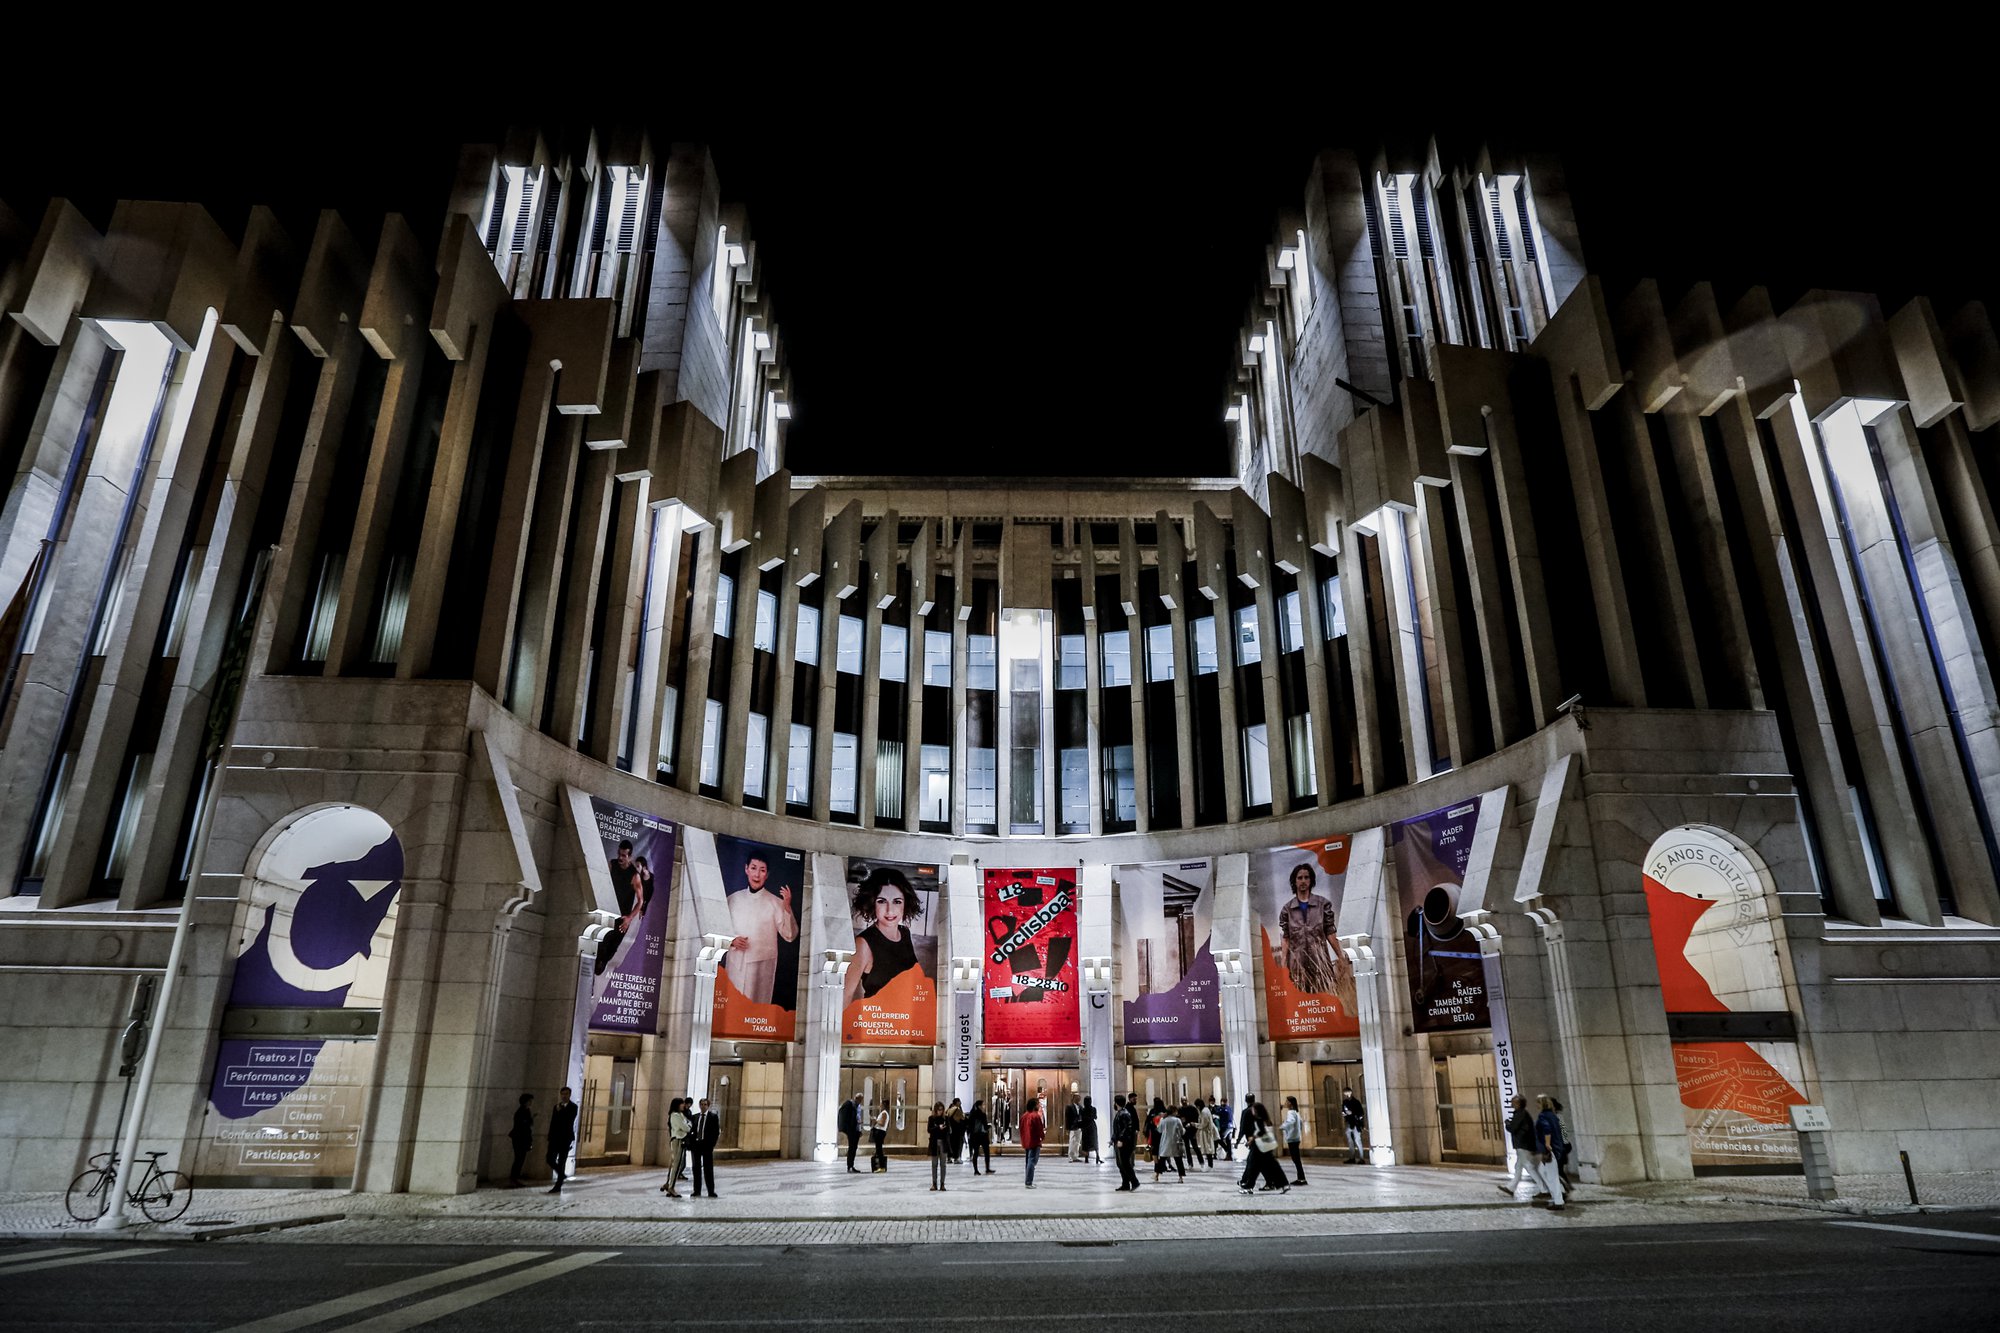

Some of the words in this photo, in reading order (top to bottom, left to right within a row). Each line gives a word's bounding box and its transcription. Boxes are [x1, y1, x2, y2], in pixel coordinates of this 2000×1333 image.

[594, 812, 632, 830] CONCERTOS
[614, 810, 624, 818] OS
[626, 814, 639, 824] SEIS
[600, 822, 638, 839] BRANDEBUR
[600, 830, 620, 842] UESES
[1442, 824, 1464, 838] KADER
[1440, 836, 1456, 846] ATTIA
[1652, 862, 1668, 880] 25
[1667, 848, 1704, 866] ANOS
[1710, 855, 1752, 938] CULTURGEST
[992, 894, 1074, 964] doclisboa
[606, 972, 624, 980] ANNE
[625, 974, 646, 983] TERESA
[648, 978, 656, 986] DE
[1452, 980, 1462, 988] AS
[610, 981, 654, 992] KEERSMAEKER
[1458, 986, 1482, 996] RAÍZES
[623, 991, 644, 1000] ROSAS,
[598, 997, 632, 1007] AMANDINE
[634, 1000, 652, 1009] BEYER
[1298, 1000, 1320, 1008] JAMES
[1434, 996, 1463, 1007] TAMBÉM
[1464, 996, 1474, 1004] SE
[1294, 1010, 1299, 1018] &
[1308, 1006, 1336, 1014] HOLDEN
[1428, 1008, 1450, 1016] CRIAM
[1450, 1006, 1462, 1014] NO
[602, 1014, 640, 1024] ORCHESTRA
[872, 1012, 910, 1020] GUERREIRO
[1286, 1018, 1299, 1026] THE
[1300, 1016, 1327, 1024] ANIMAL
[1453, 1012, 1475, 1022] BETÃO
[1292, 1024, 1316, 1032] SPIRITS
[958, 1014, 972, 1082] Culturgest
[254, 1052, 286, 1062] Teatro
[1680, 1054, 1706, 1064] Teatro
[230, 1072, 296, 1082] Performance
[1742, 1066, 1772, 1077] Música
[1496, 1040, 1515, 1122] ulturgest
[1678, 1068, 1729, 1090] Performance
[249, 1091, 277, 1100] Artes
[280, 1091, 317, 1100] Visuais
[1762, 1084, 1787, 1099] Dança
[1738, 1100, 1771, 1114] Cinema
[289, 1111, 322, 1121] Cinem
[1694, 1140, 1752, 1152] Conferências
[1754, 1144, 1760, 1152] e
[1762, 1143, 1799, 1154] Debates
[246, 1150, 311, 1162] Participação
